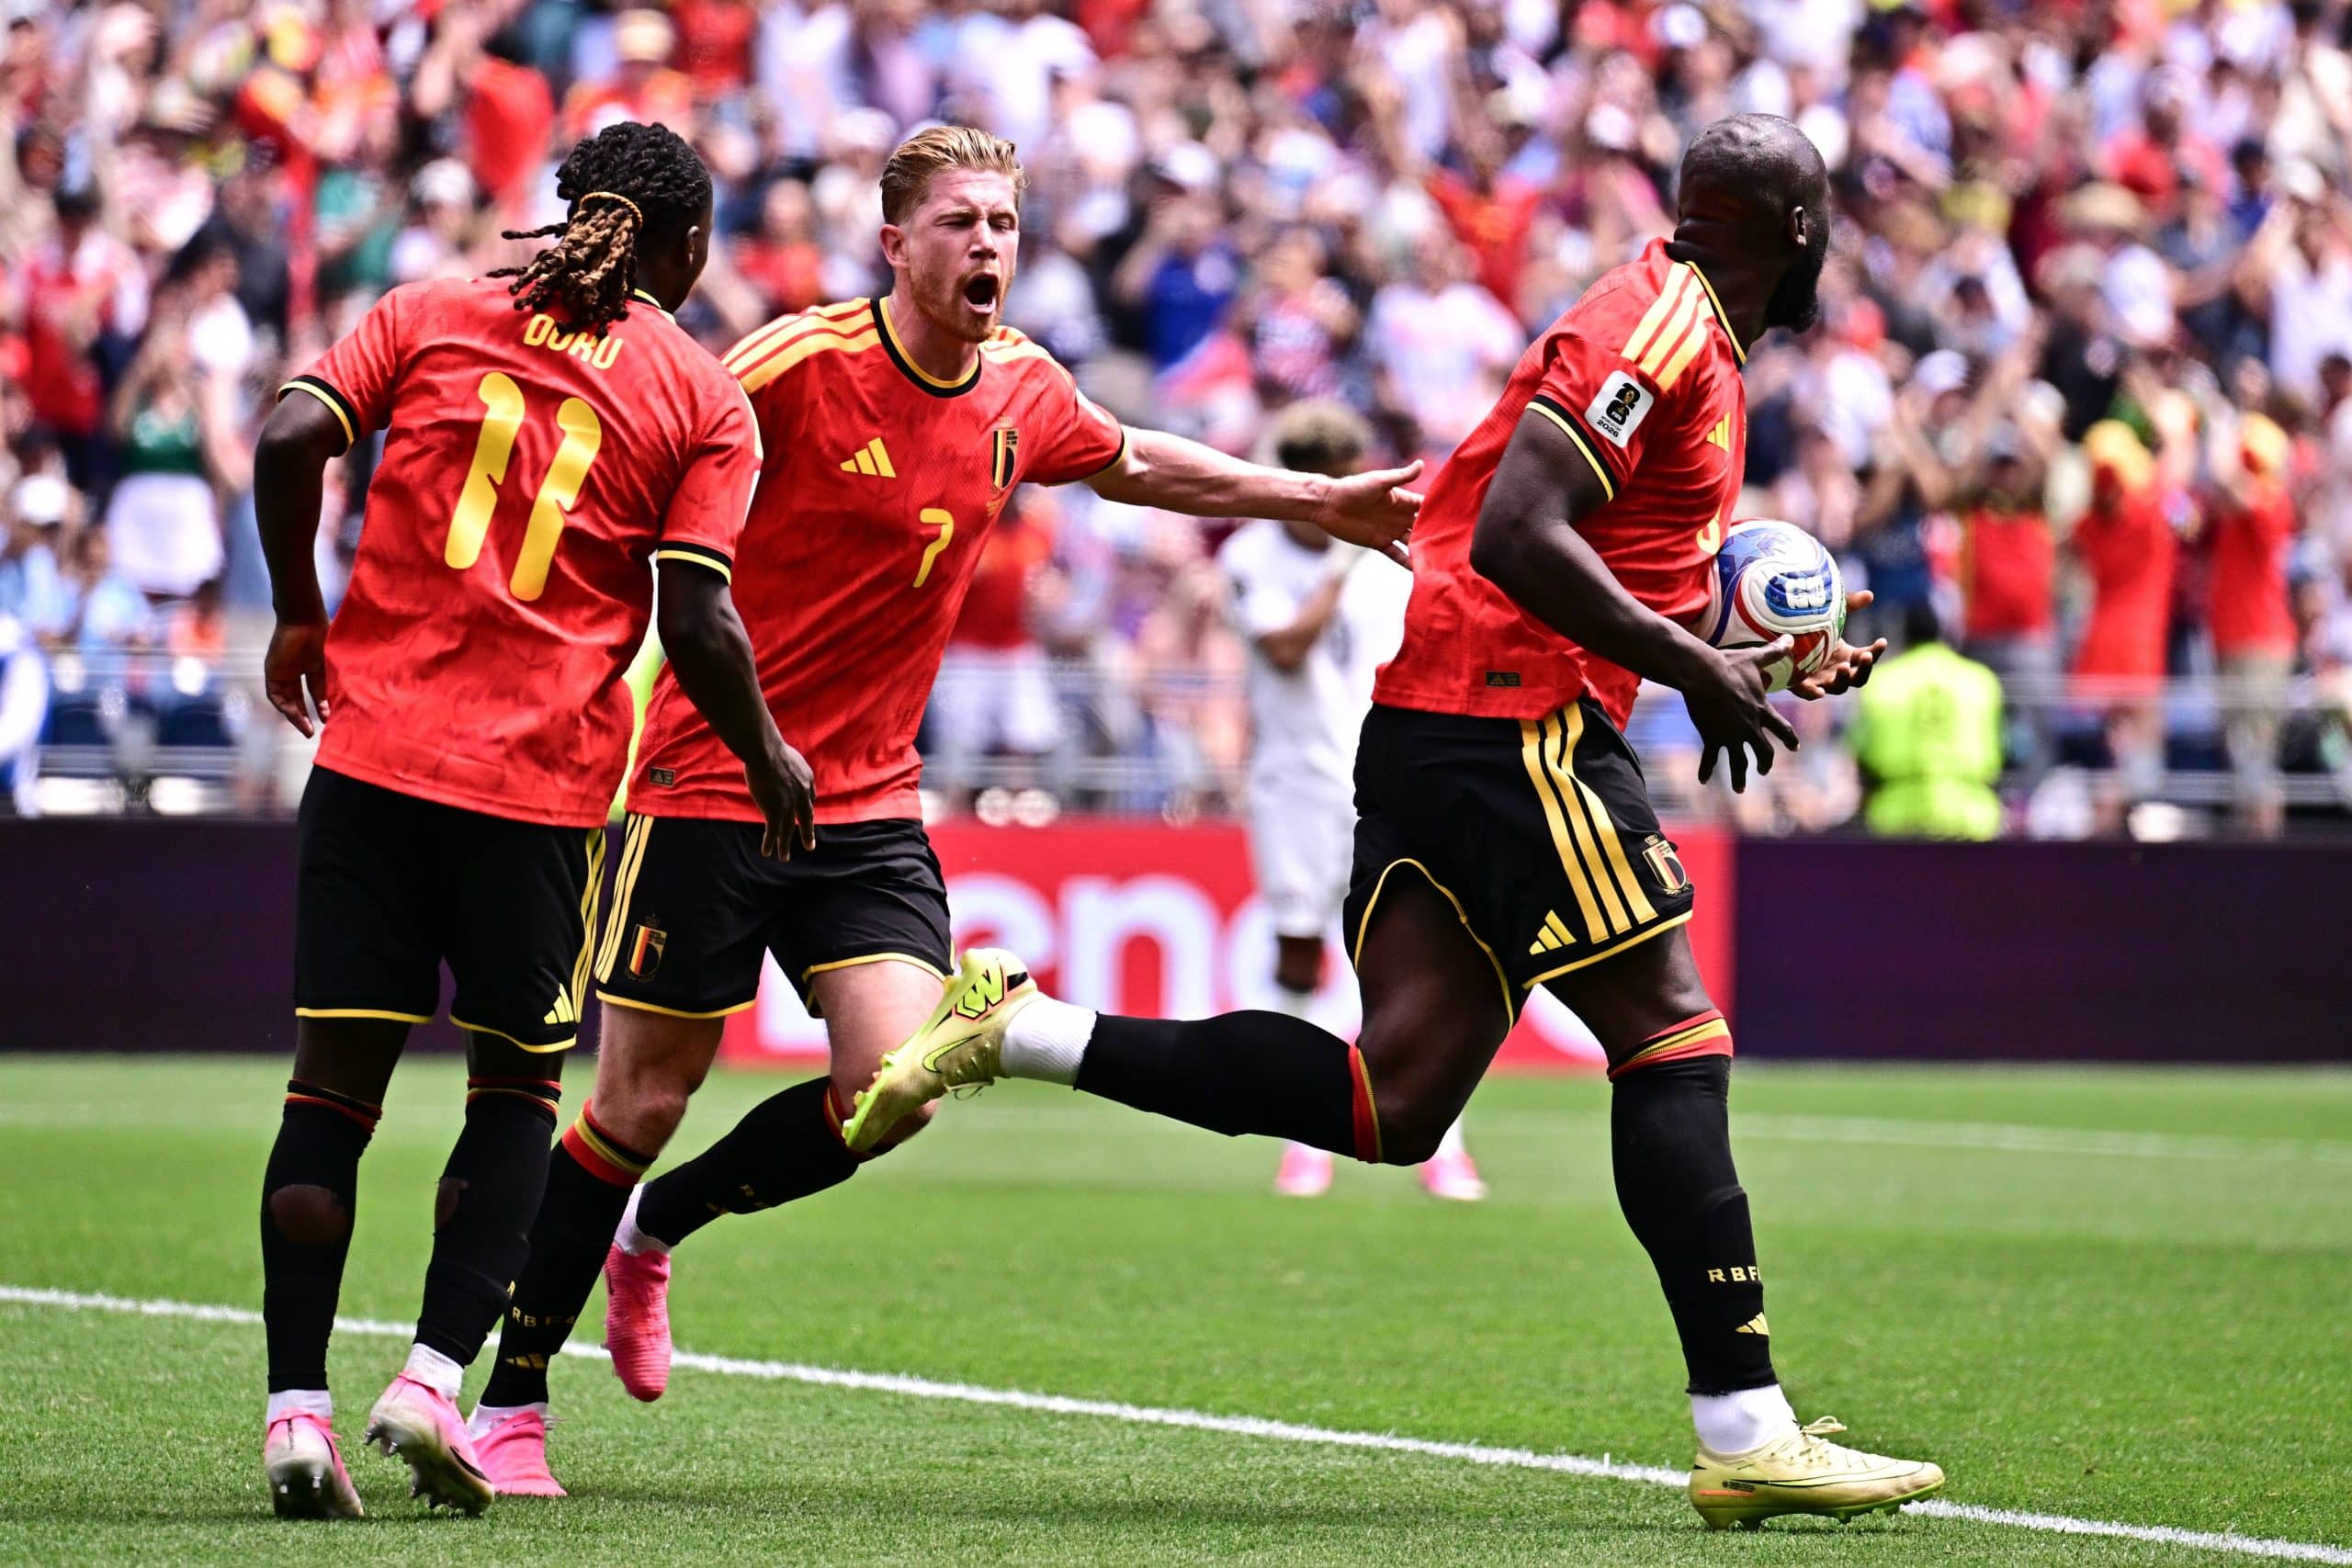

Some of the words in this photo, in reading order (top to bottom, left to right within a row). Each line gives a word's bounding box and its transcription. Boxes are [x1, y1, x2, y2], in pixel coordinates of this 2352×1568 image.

[444, 371, 602, 602] 11
[913, 508, 954, 588] 7
[1707, 1266, 1761, 1282] RBF
